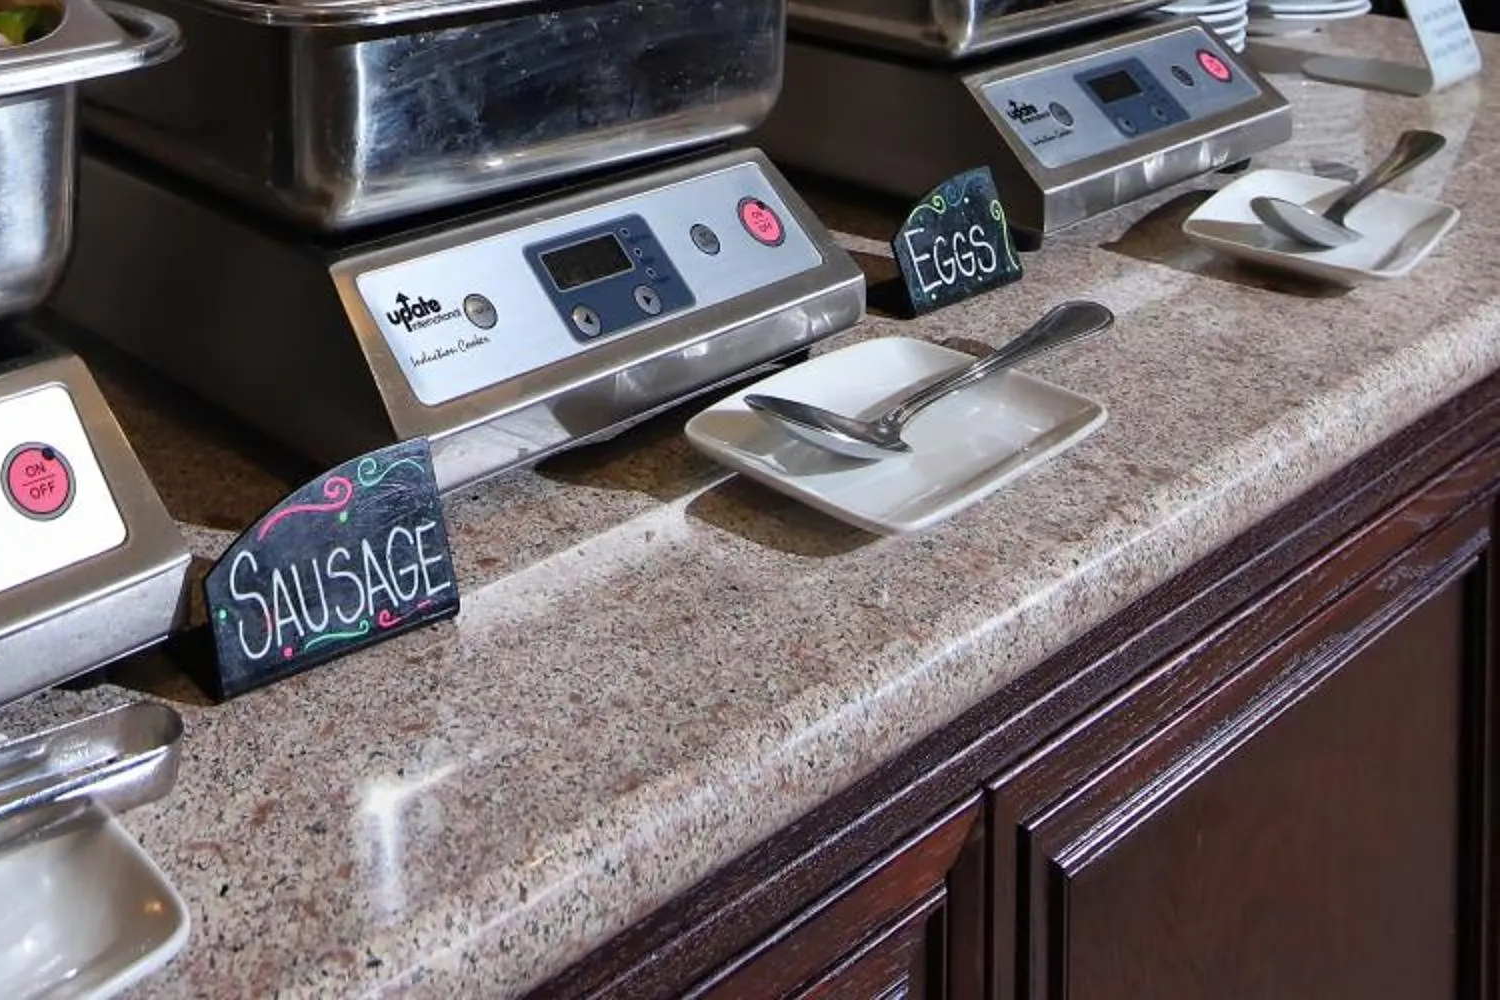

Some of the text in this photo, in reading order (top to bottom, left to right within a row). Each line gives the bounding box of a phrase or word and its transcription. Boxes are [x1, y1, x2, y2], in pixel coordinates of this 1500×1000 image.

[904, 225, 996, 292] EGGS
[386, 291, 441, 332] update
[25, 462, 46, 478] ON
[29, 481, 56, 500] OFF
[230, 520, 451, 659] SAUSAGE
